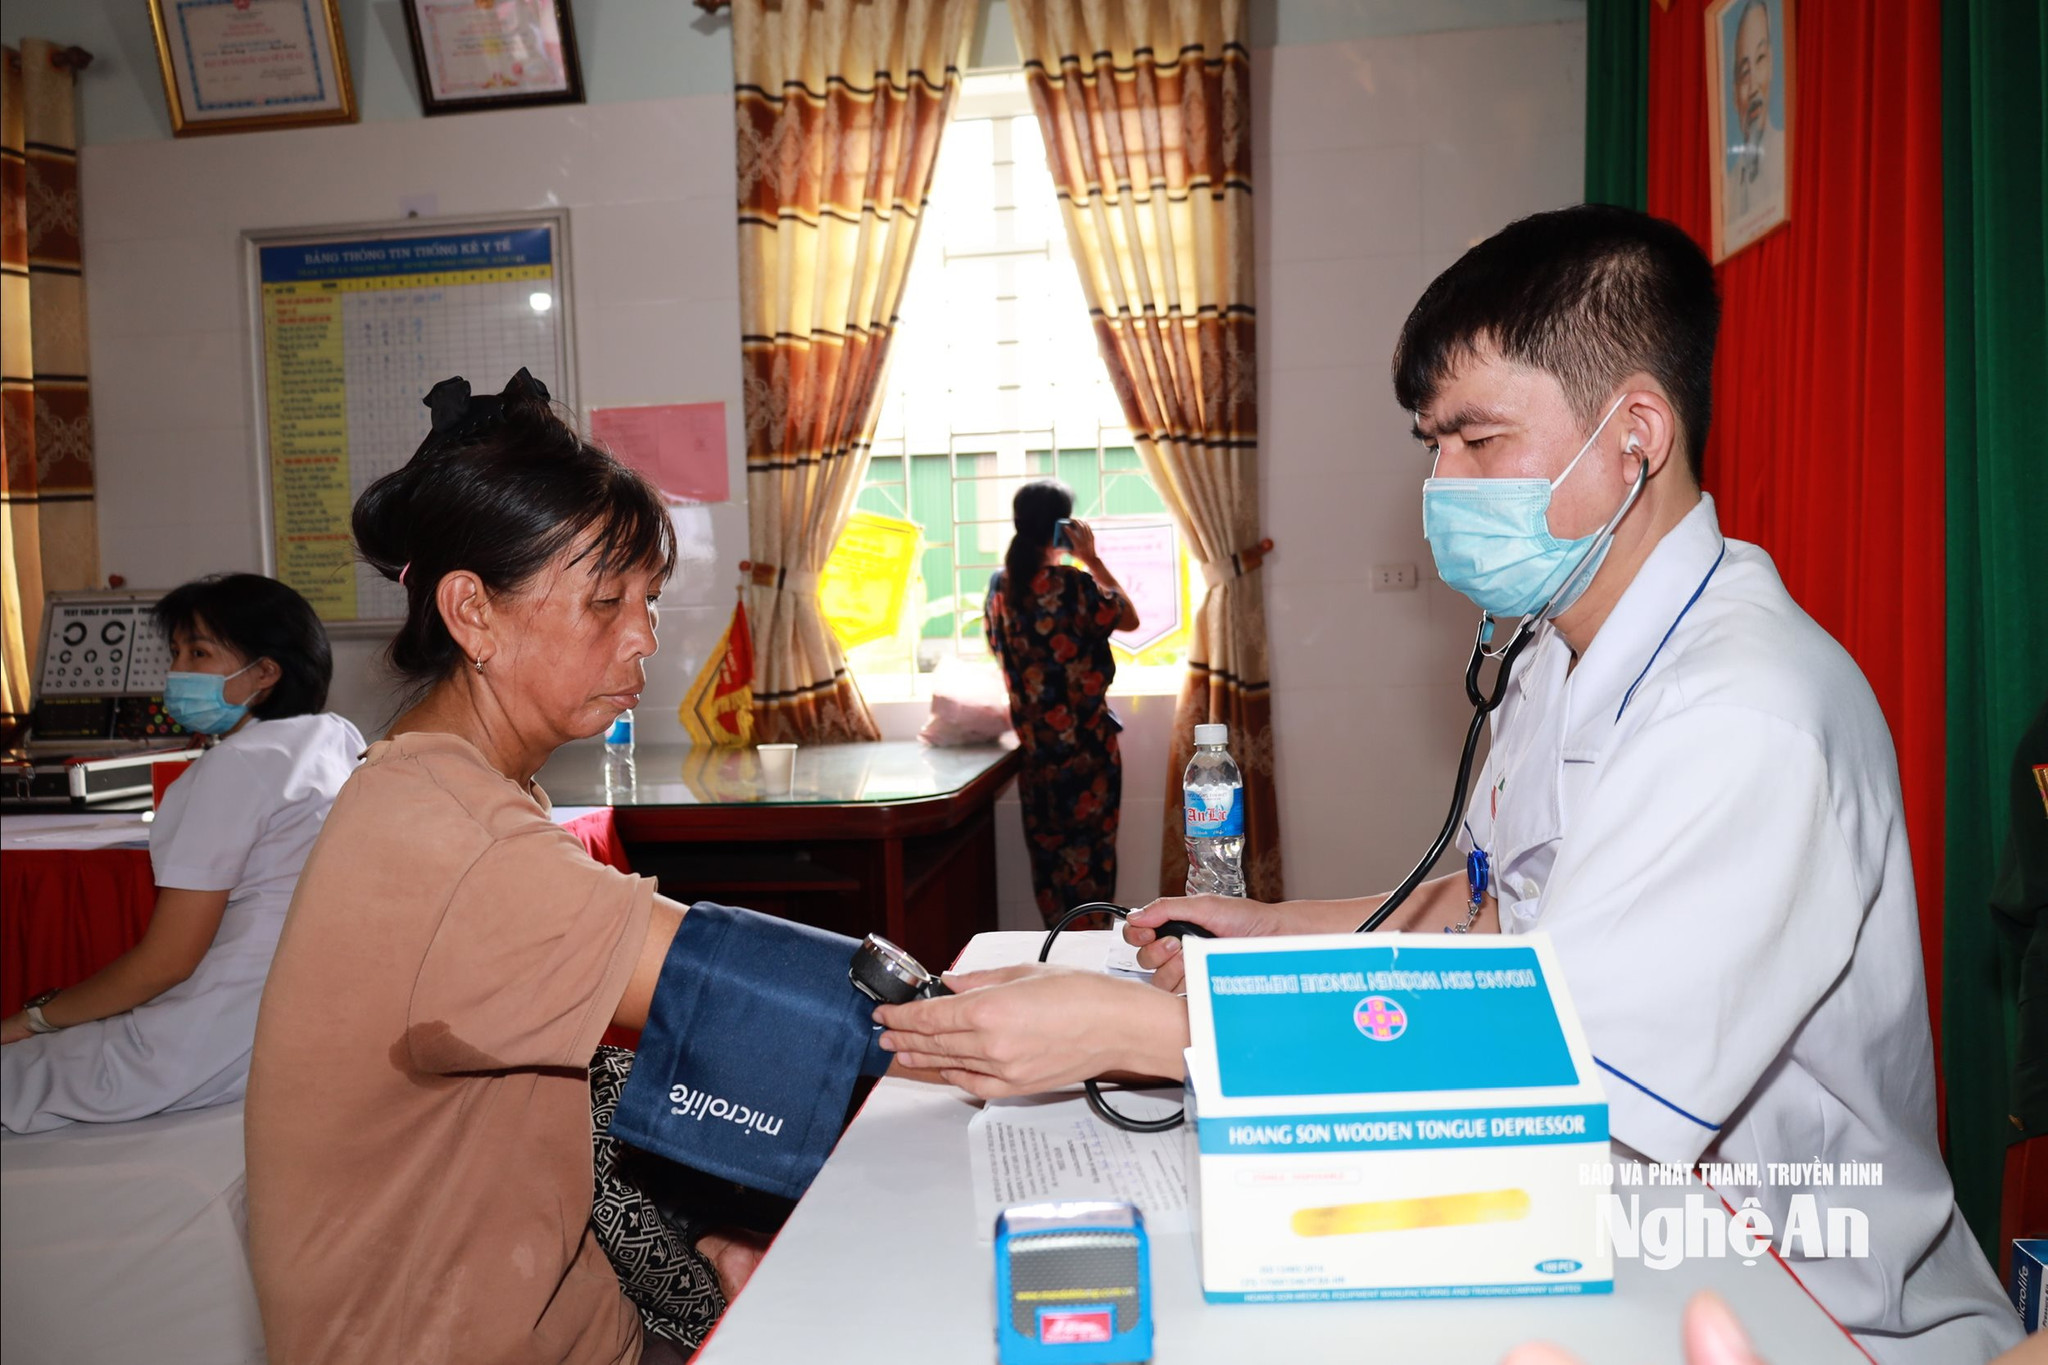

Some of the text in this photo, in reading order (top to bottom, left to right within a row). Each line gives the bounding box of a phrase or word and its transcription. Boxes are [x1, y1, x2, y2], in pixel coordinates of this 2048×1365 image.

[342, 247, 385, 262] THÔNG
[388, 247, 411, 259] TIN
[482, 241, 491, 253] Y
[1300, 972, 1367, 993] TONGUE
[1440, 970, 1475, 990] SON
[1474, 968, 1537, 989] HOANG
[669, 1083, 784, 1136] microlife
[1228, 1114, 1586, 1145] HOANG SON WOODEN TONGUE DEPRESSOR
